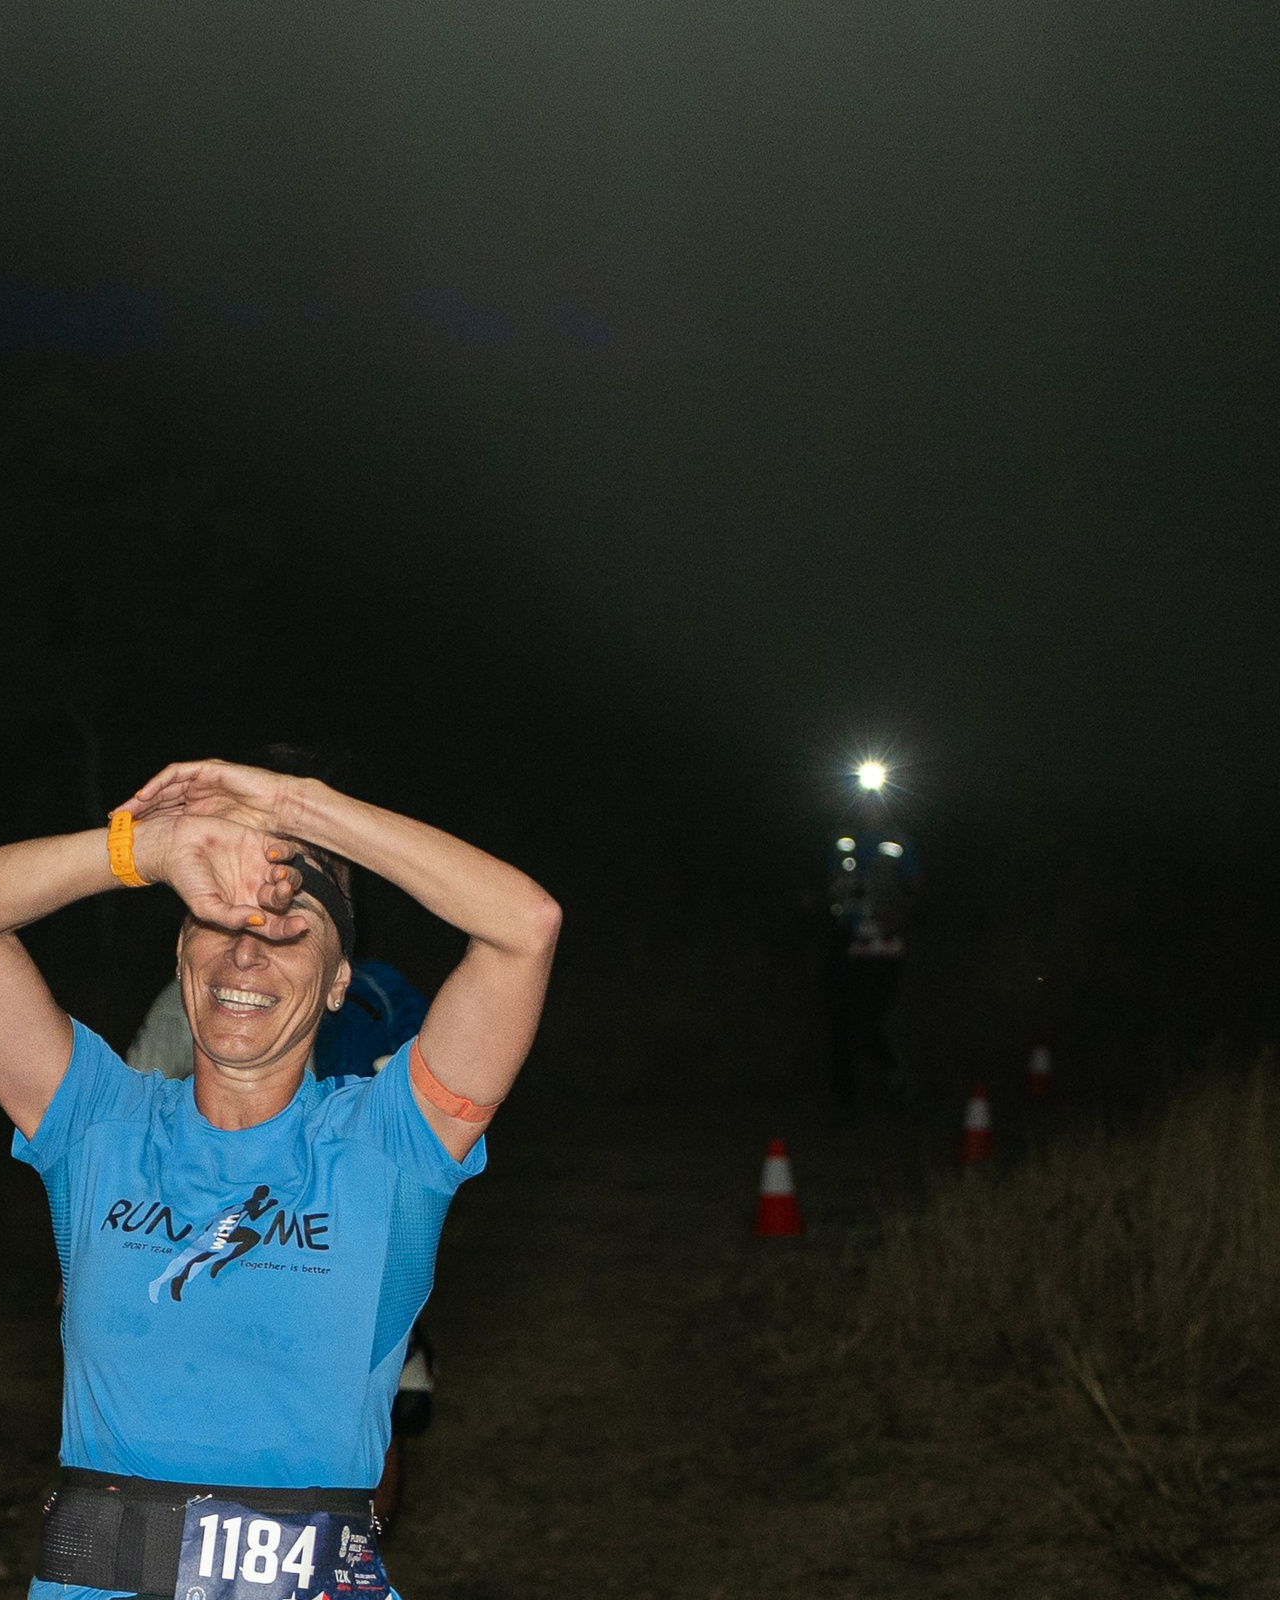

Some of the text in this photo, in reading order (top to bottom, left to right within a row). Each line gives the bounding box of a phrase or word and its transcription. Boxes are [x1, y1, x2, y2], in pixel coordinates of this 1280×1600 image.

[100, 1199, 329, 1250] RUN with ME
[122, 1241, 173, 1254] SPORT TEAM
[240, 1260, 331, 1275] Together is better
[199, 1513, 317, 1590] 1184
[334, 1569, 351, 1584] 12K
